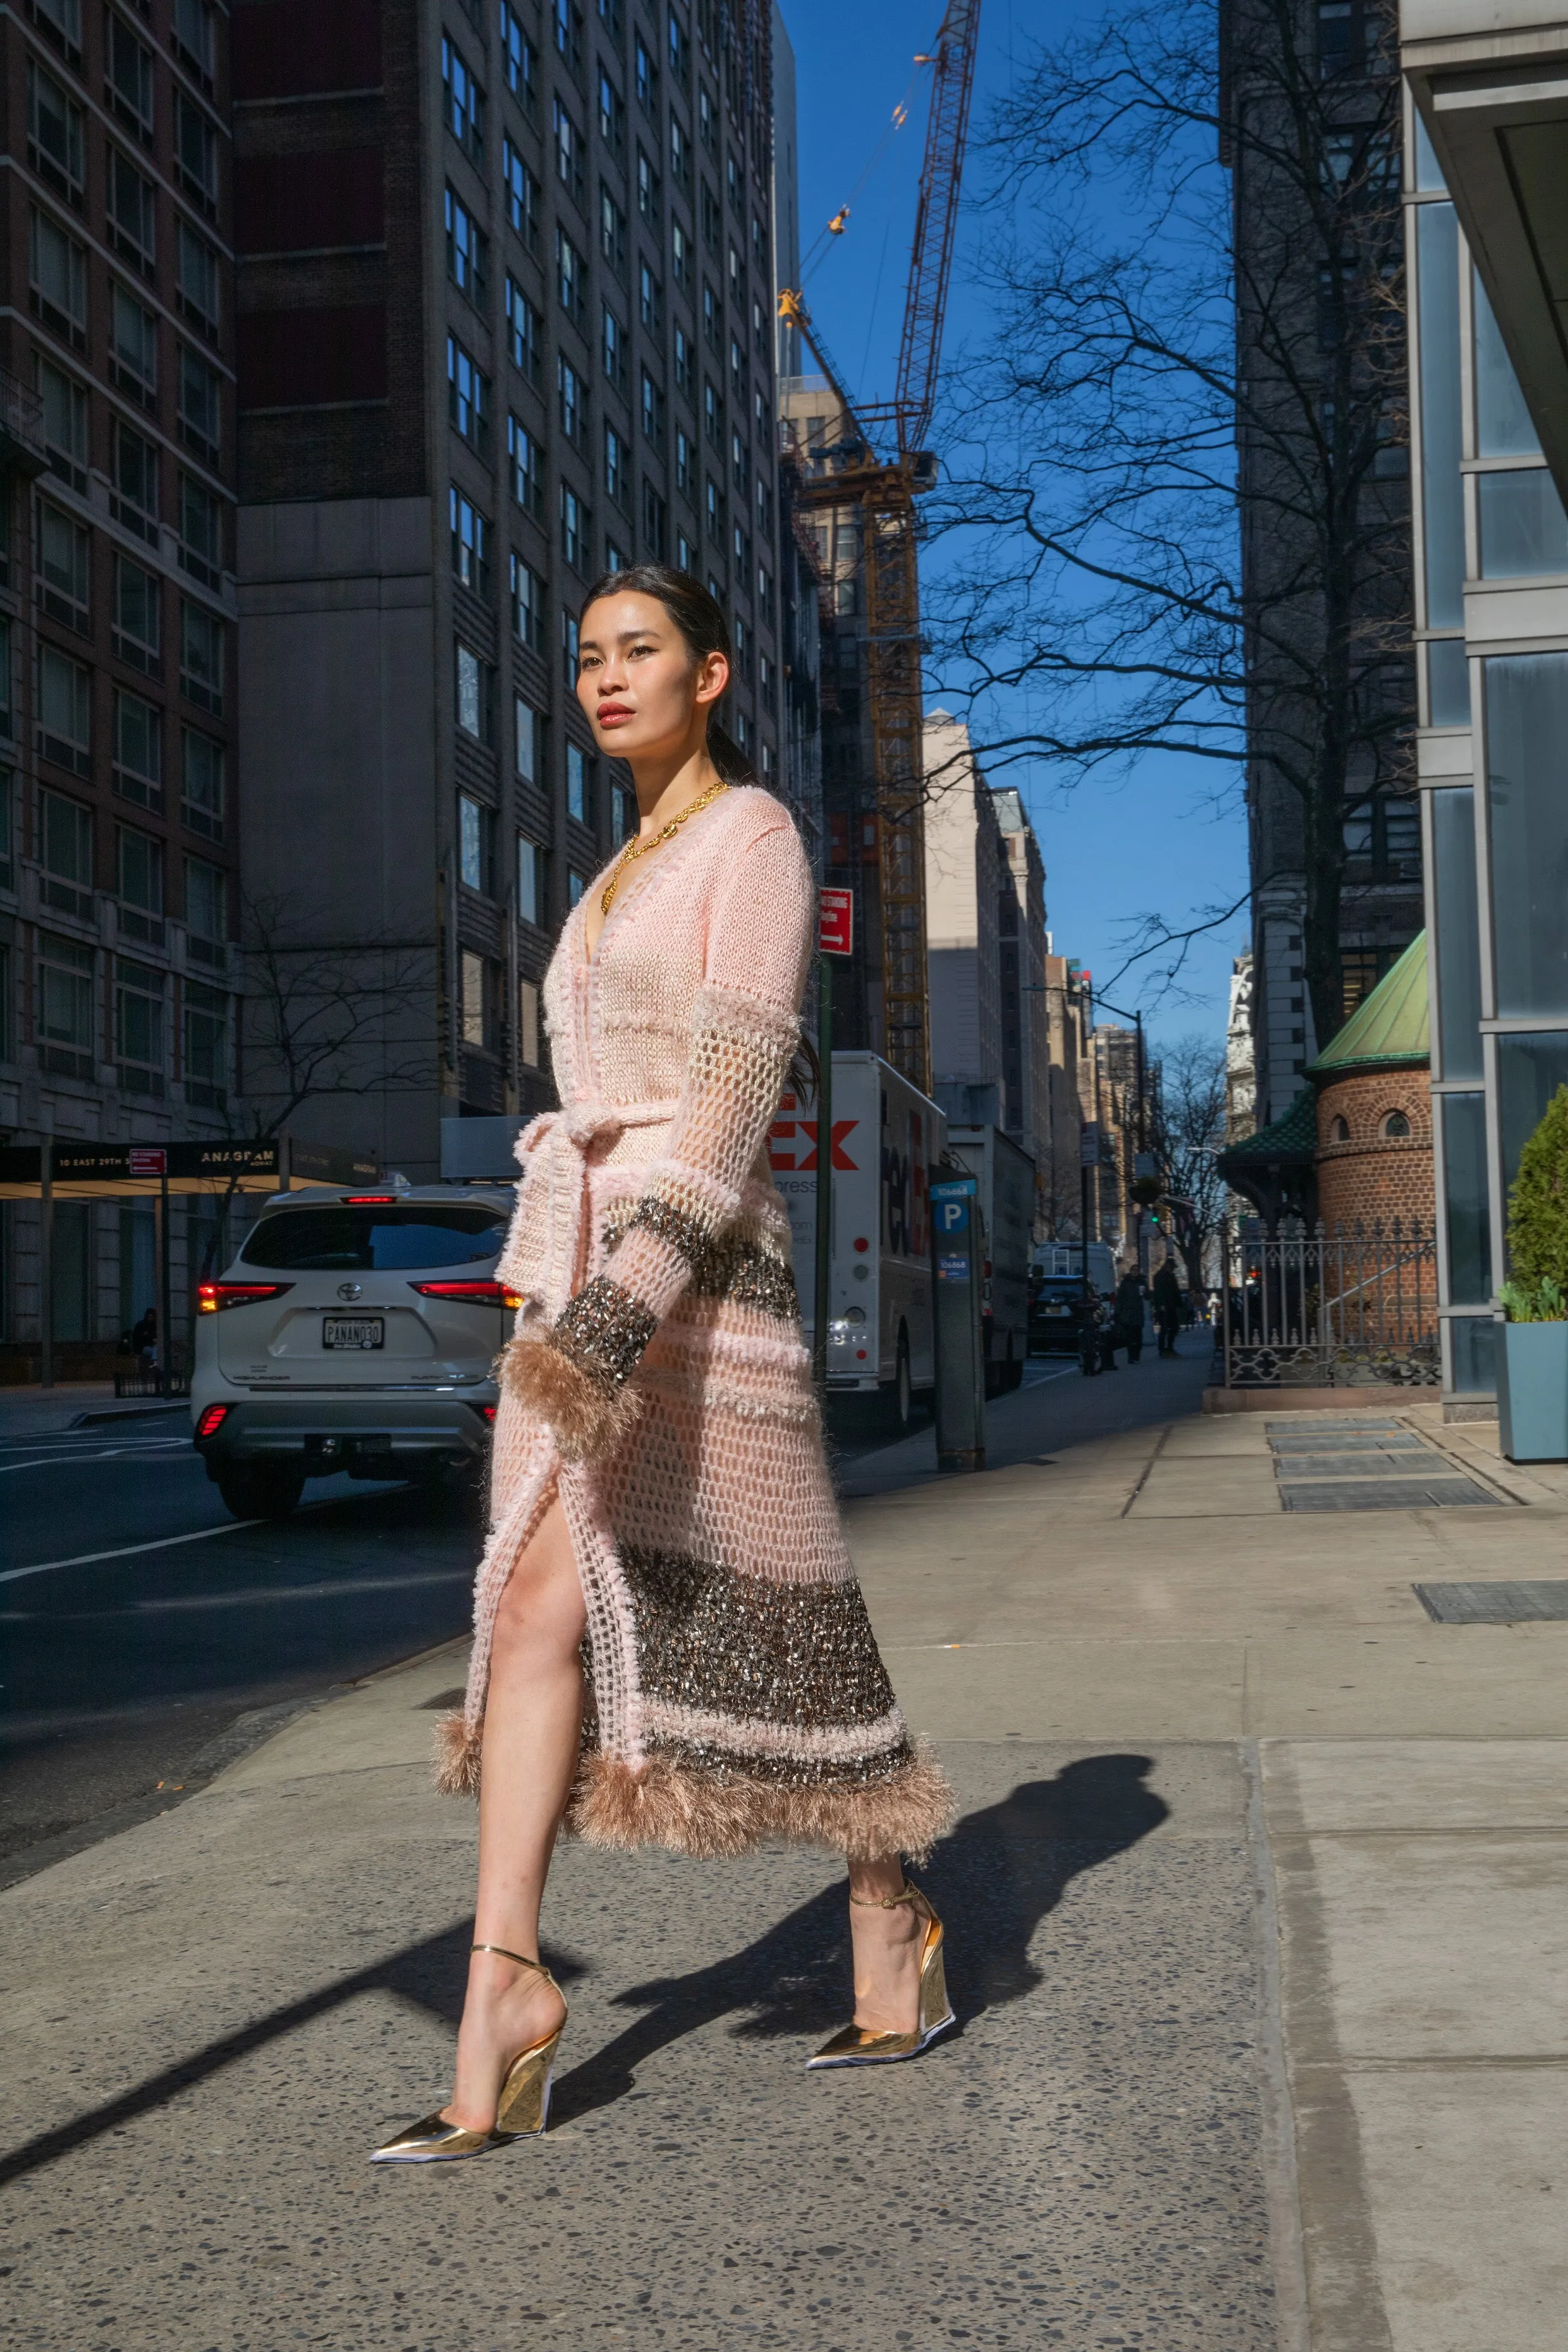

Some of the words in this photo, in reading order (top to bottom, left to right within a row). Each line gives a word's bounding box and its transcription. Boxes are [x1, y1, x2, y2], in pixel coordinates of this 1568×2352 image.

[73, 1158, 95, 1167] EAST
[98, 1158, 122, 1166] 29TH
[944, 1204, 962, 1230] P
